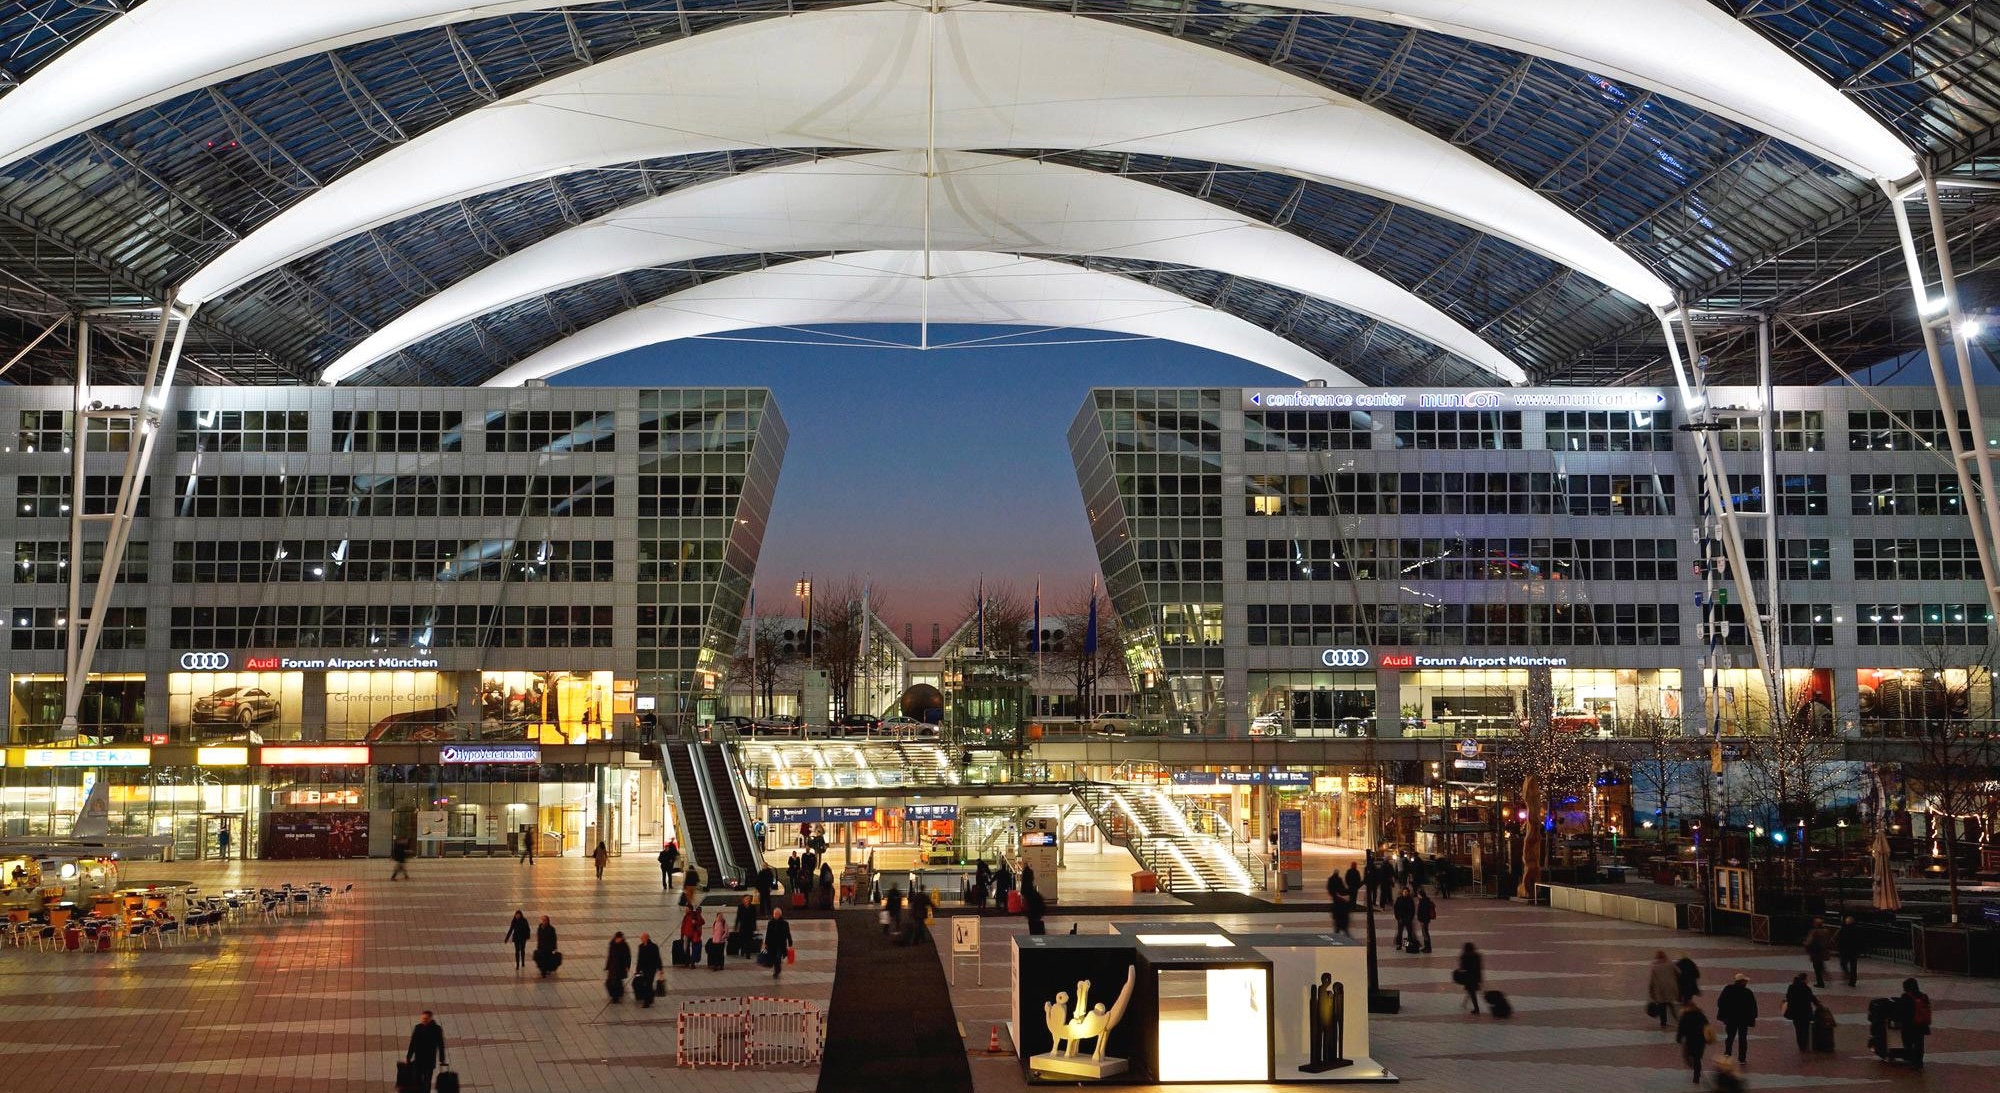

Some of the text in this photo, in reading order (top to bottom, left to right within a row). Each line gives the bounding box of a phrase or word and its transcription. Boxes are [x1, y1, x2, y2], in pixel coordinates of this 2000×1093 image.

[1266, 391, 1648, 407] conference center municon www.municon.de
[247, 656, 438, 671] Audi Forum Airport München
[1382, 655, 1567, 669] Audi Forum Airport München
[334, 693, 404, 702] Conference
[69, 751, 133, 762] EDEKA
[455, 748, 537, 762] HypoVereinsbank
